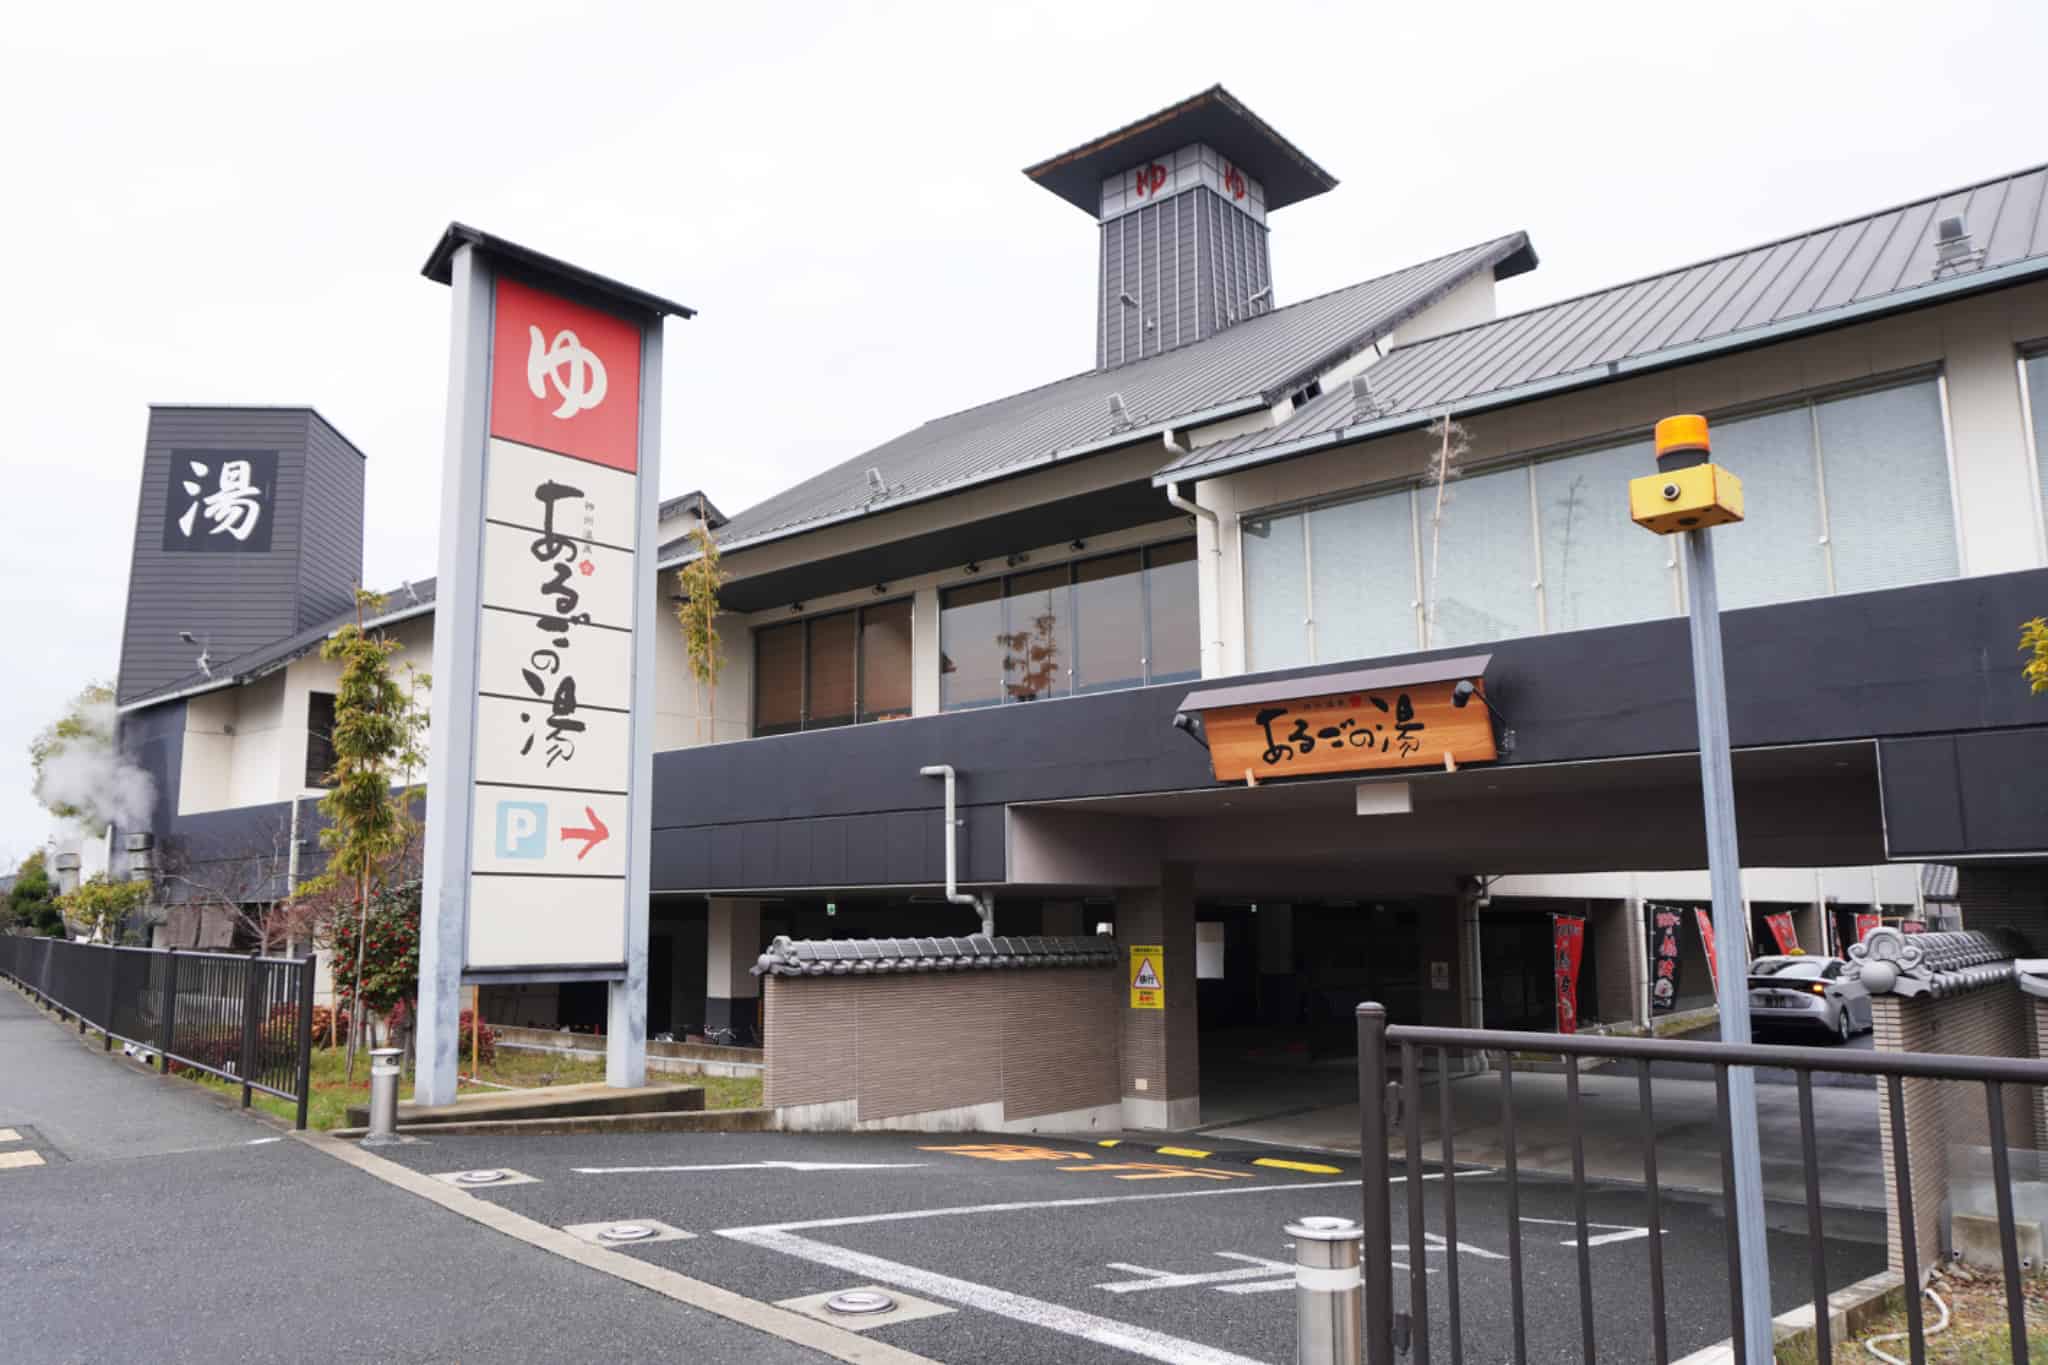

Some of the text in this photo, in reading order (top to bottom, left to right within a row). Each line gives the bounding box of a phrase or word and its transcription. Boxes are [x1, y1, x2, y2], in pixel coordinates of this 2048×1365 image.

[1136, 163, 1167, 199] ゆ
[1224, 161, 1245, 199] ゆ
[527, 323, 607, 419] ゆ
[178, 459, 262, 540] 湯
[505, 807, 537, 851] P
